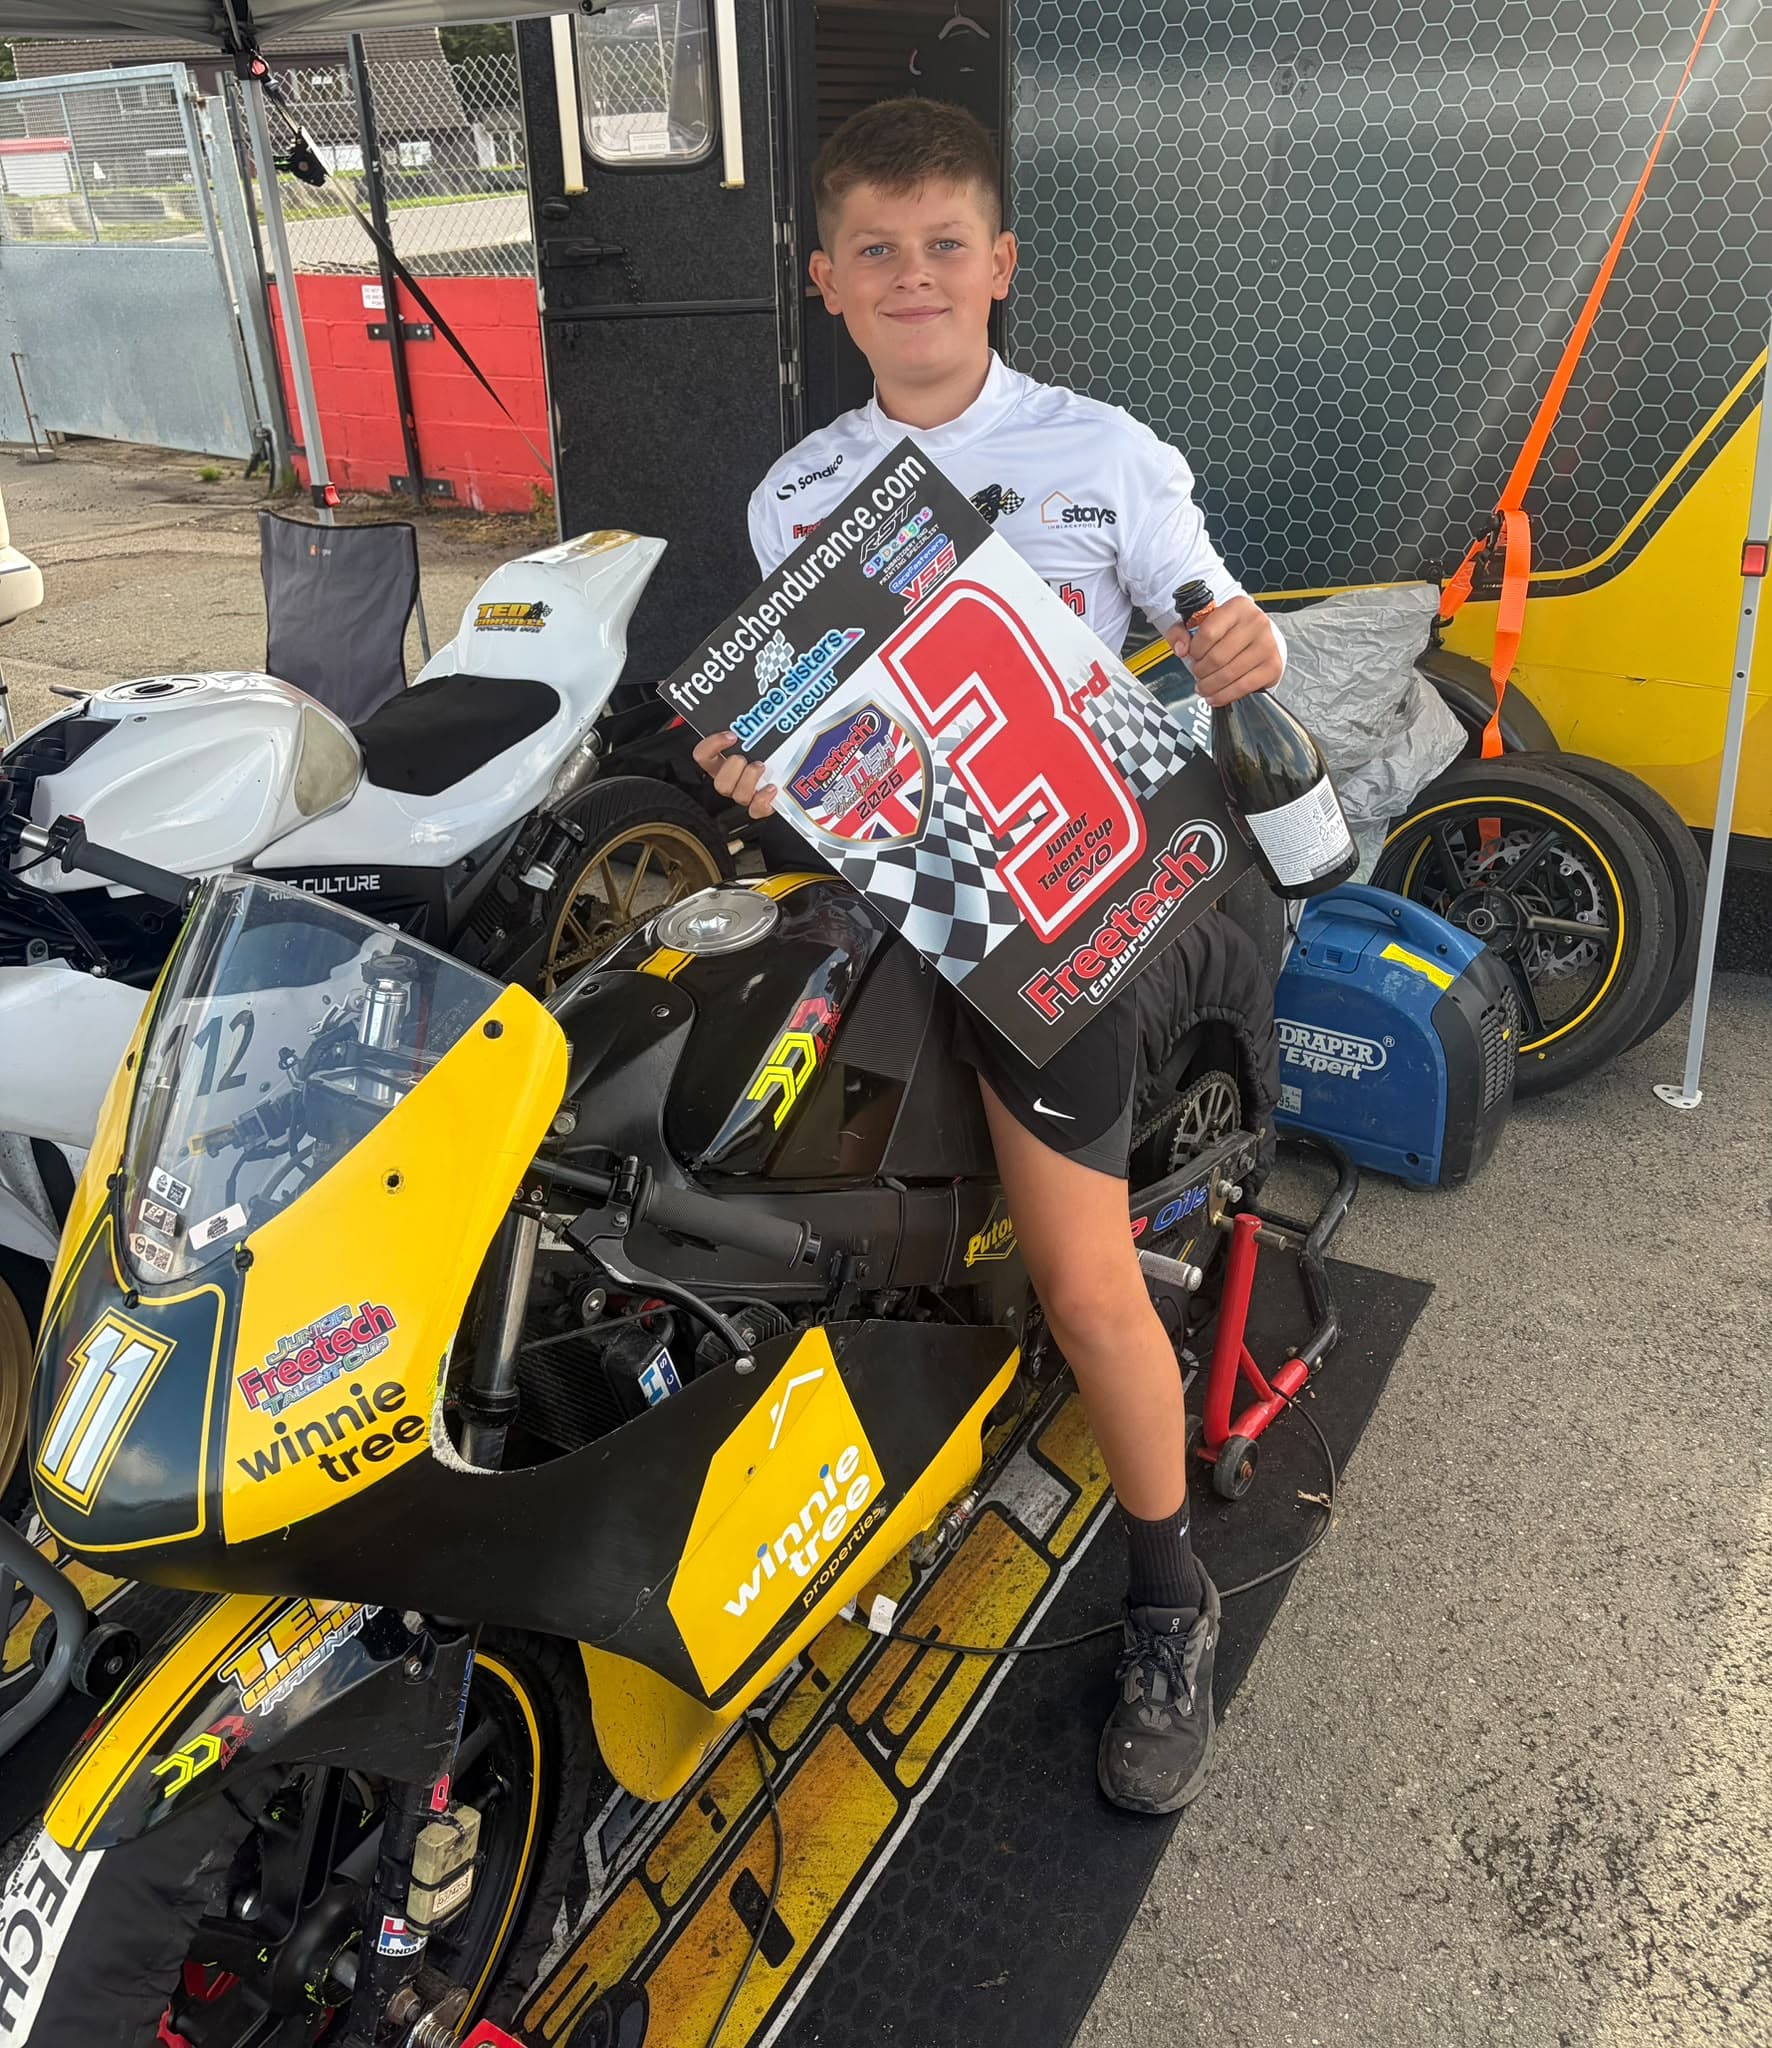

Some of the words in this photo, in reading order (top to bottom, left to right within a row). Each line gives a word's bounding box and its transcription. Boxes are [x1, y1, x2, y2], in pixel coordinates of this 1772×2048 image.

[798, 454, 843, 489] Sondico
[860, 490, 916, 564] RST
[1061, 505, 1117, 528] stays
[478, 603, 532, 619] TED
[669, 456, 927, 711] freetechendurance.com
[900, 540, 957, 615] YSS
[732, 689, 785, 739] three
[782, 631, 843, 692] sisters
[777, 669, 837, 731] CIRCUIT
[794, 722, 874, 800] Freetech
[822, 735, 896, 816] BRITISH
[856, 769, 904, 820] 2026
[884, 585, 1142, 938] 3
[1071, 660, 1111, 714] rd
[1038, 849, 1085, 891] Talent
[1083, 818, 1113, 849] Cup
[1047, 812, 1088, 861] Junior
[1066, 843, 1113, 893] EVO
[302, 875, 381, 894] CULTURE
[1025, 852, 1209, 1018] Freetech
[1089, 895, 1176, 999] Endurance
[1279, 1024, 1374, 1065] DRAPER
[1285, 1048, 1363, 1081] Expert
[237, 1302, 397, 1409] Freetech
[41, 1323, 158, 1495] 11
[237, 1381, 407, 1483] winnie
[318, 1415, 426, 1483] tree
[723, 1445, 860, 1617] winnie
[788, 1474, 870, 1577] tree
[802, 1507, 882, 1608] properties
[378, 1945, 417, 1956] HONDA
